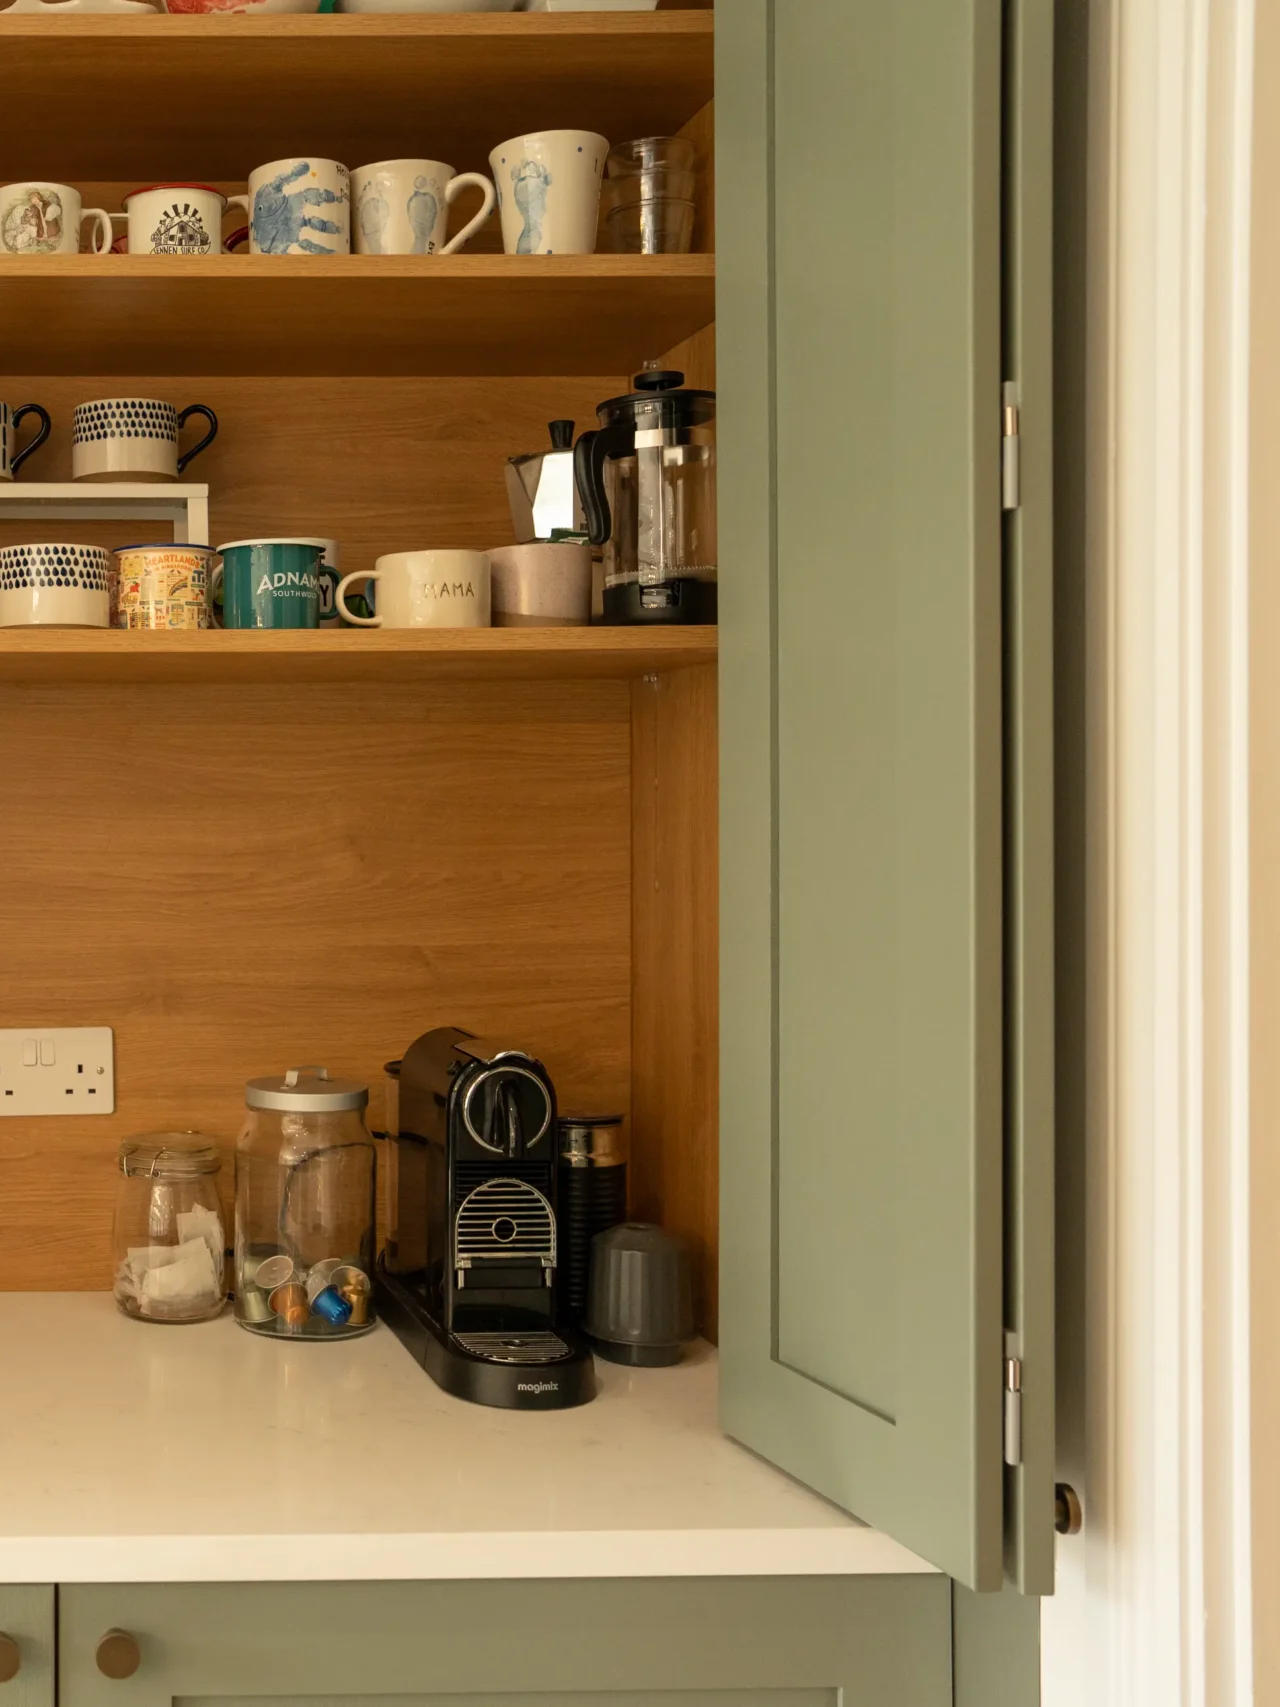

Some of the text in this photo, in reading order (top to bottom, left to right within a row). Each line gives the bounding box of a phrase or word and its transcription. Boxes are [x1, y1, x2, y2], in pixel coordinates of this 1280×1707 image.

[181, 246, 196, 255] SURF
[145, 553, 200, 570] HEARTLANDS
[423, 581, 475, 600] MAMA
[517, 1381, 559, 1394] magimix
